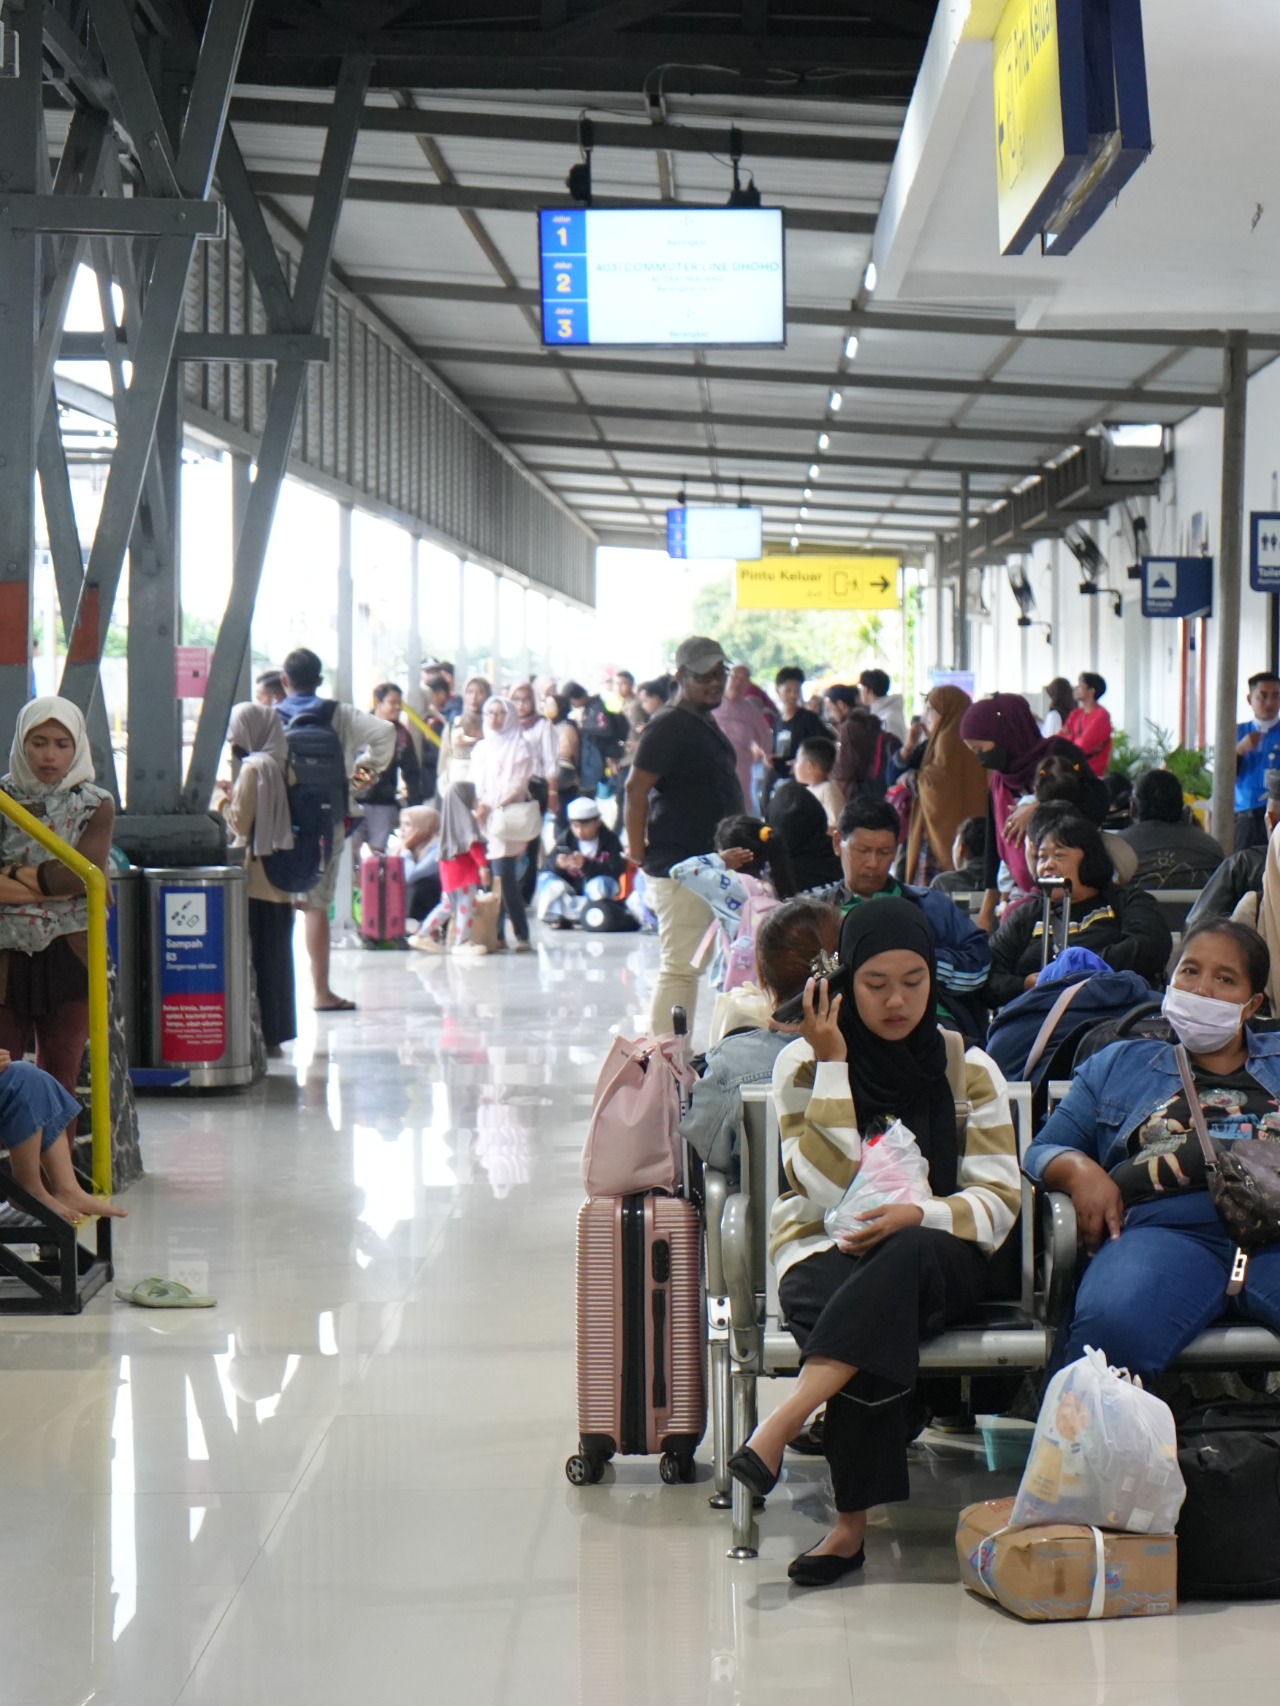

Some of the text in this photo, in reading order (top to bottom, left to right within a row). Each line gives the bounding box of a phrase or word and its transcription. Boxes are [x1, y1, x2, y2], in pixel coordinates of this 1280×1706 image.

[557, 228, 568, 246] 1
[556, 273, 571, 292] 2
[558, 319, 572, 338] 3
[741, 568, 822, 581] Pintu Keluar
[166, 938, 203, 950] Sampah
